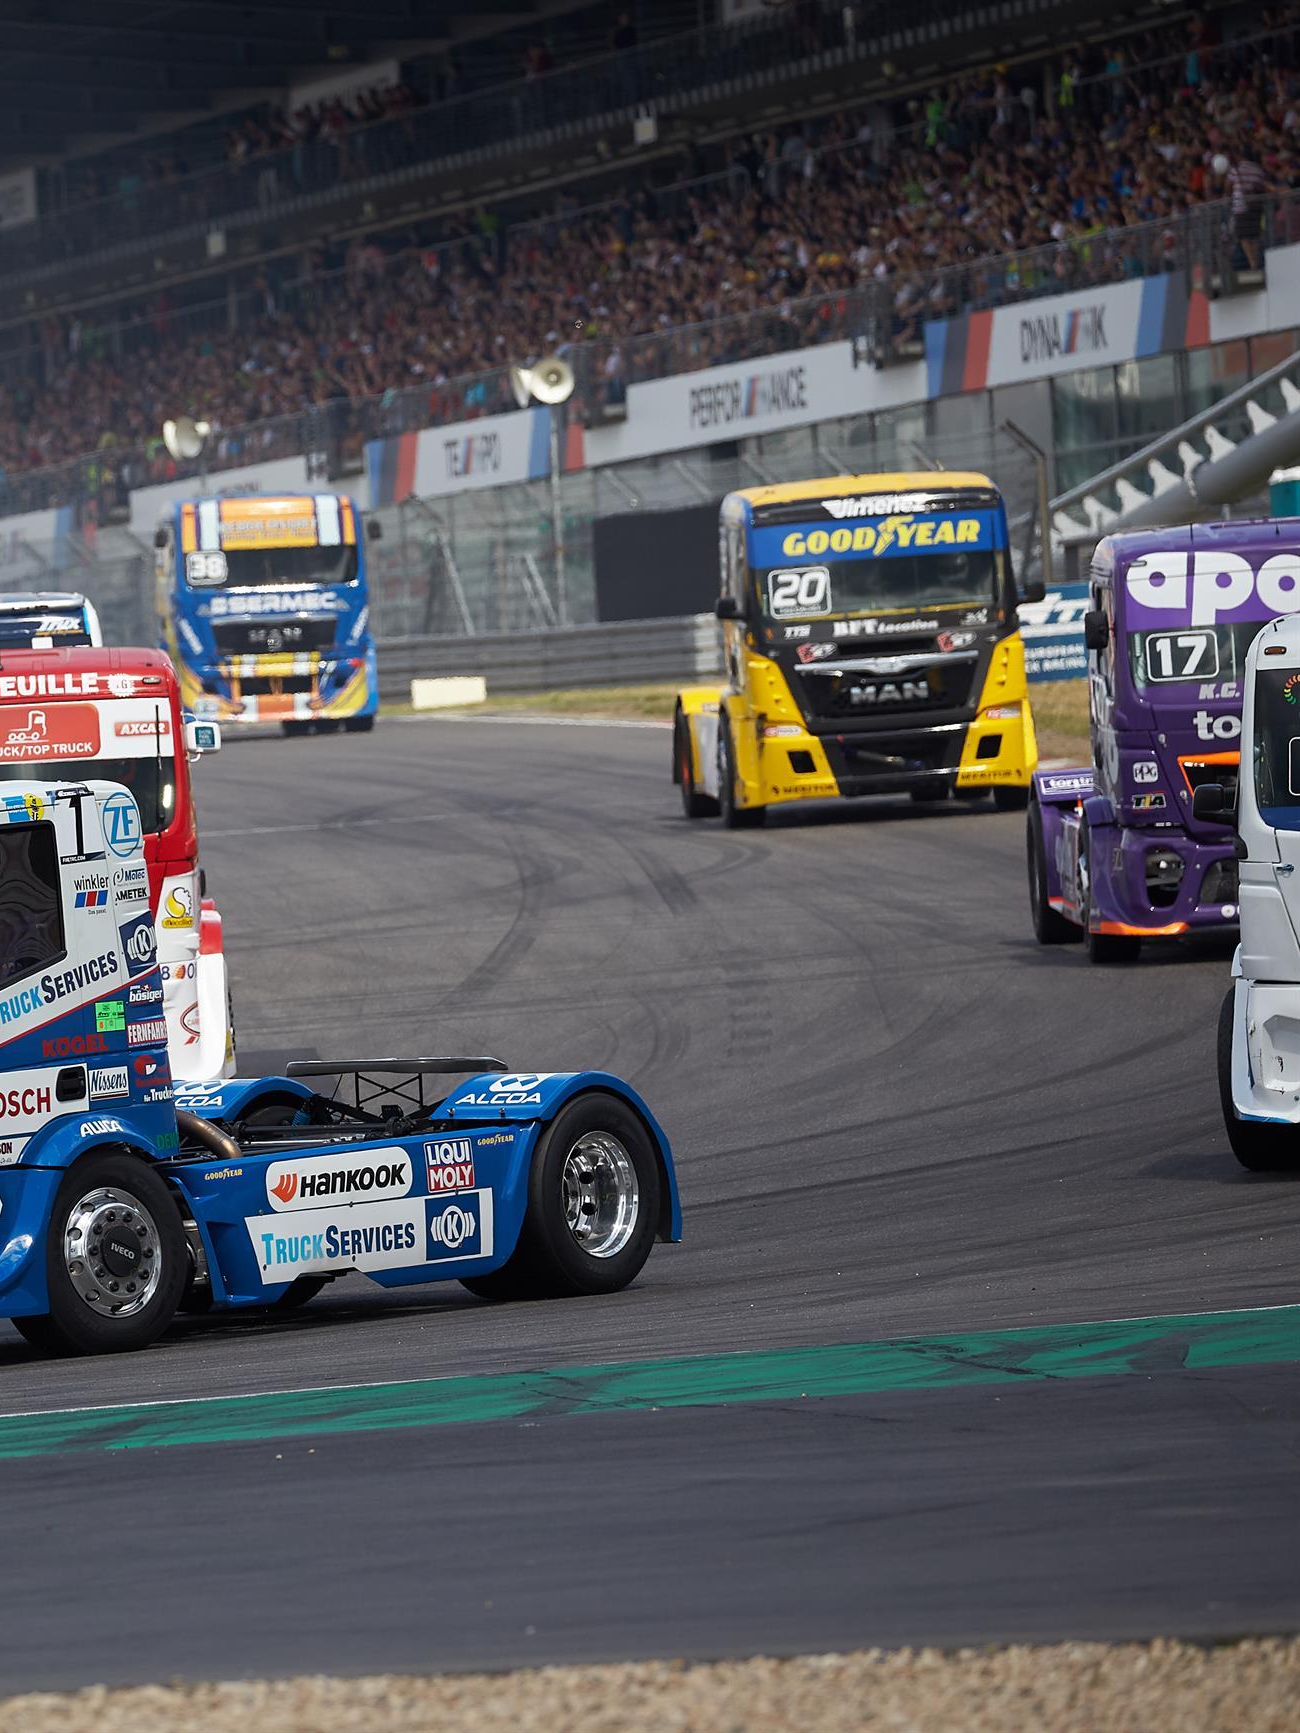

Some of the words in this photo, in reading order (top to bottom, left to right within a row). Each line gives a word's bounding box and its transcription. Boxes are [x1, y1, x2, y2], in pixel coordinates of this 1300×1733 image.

[782, 516, 981, 556] GOODYEAR
[773, 571, 826, 607] 20
[1156, 635, 1207, 677] 17
[850, 681, 929, 703] MAN
[52, 742, 93, 754] TRUCK
[104, 805, 138, 845] ZF
[74, 872, 109, 892] winkler
[115, 887, 147, 901] AMETEK
[42, 1034, 109, 1058] KÖGEL
[91, 1070, 128, 1093] Nissens
[175, 1095, 223, 1107] COA
[455, 1092, 541, 1105] ALCOA
[477, 1133, 515, 1146] GOODYEAR
[427, 1140, 471, 1167] LIQUI
[204, 1168, 243, 1181] GOODYEAR
[428, 1164, 474, 1190] MOLY
[110, 1242, 135, 1260] IVECO
